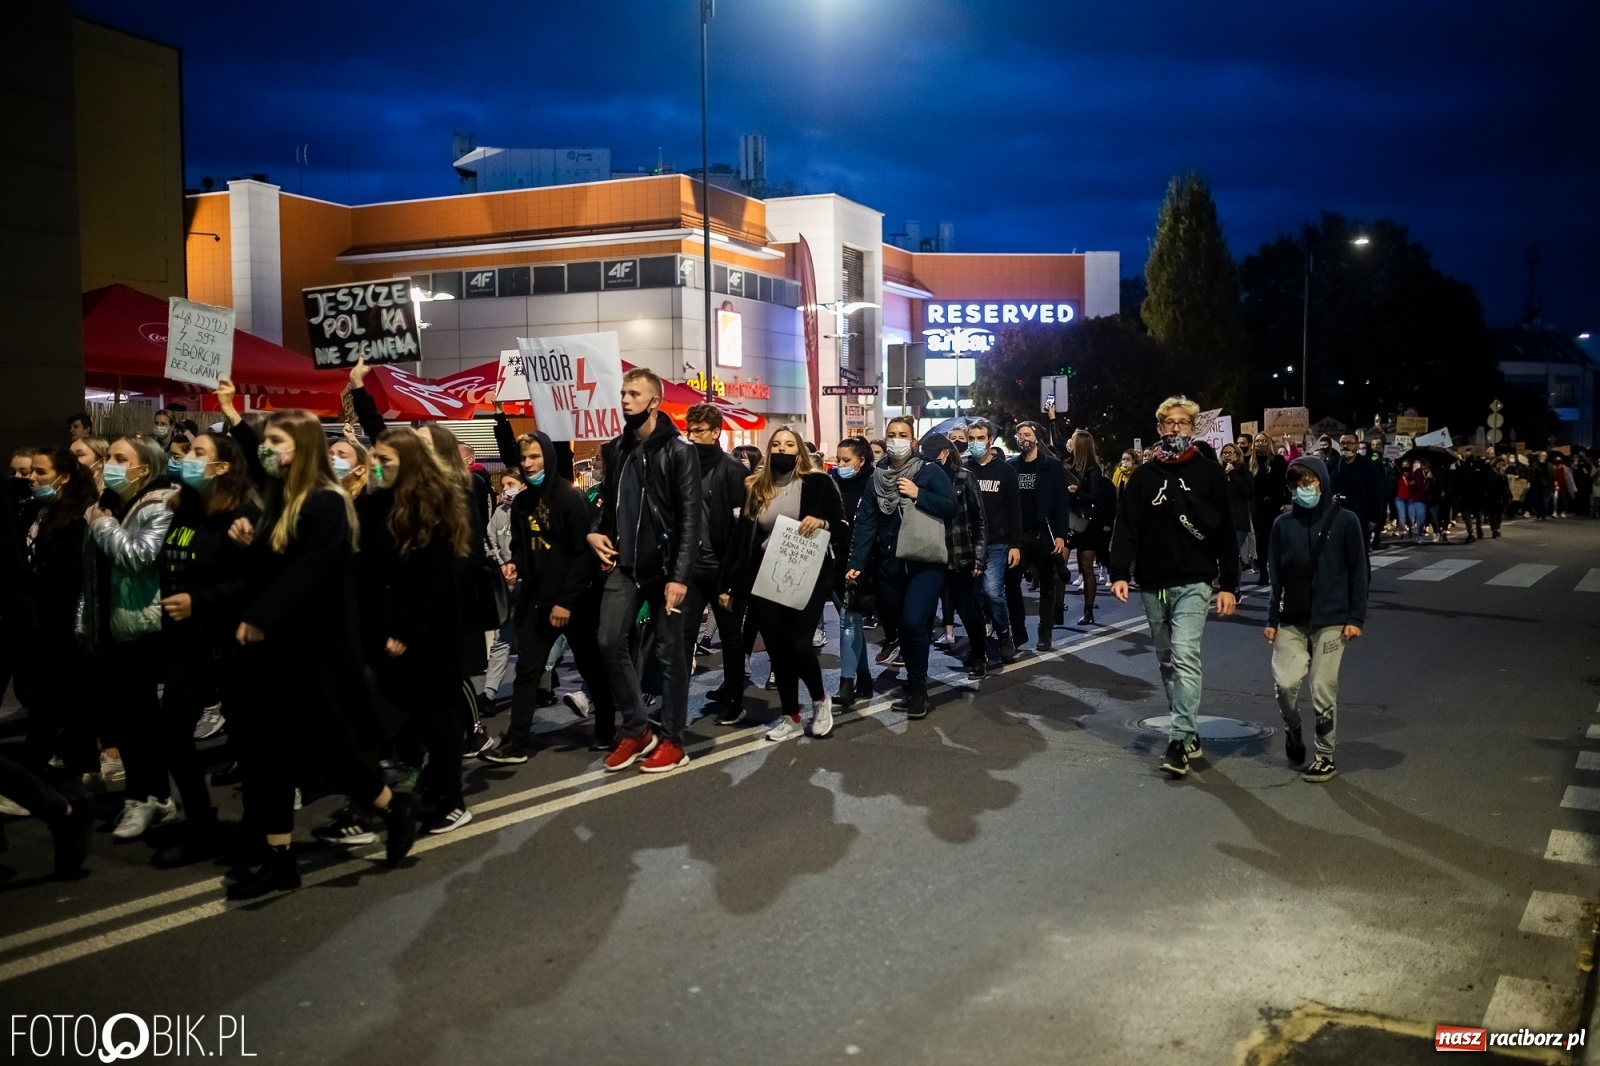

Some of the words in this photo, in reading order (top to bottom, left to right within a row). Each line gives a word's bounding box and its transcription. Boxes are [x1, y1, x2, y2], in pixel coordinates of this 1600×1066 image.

[470, 272, 493, 287] 4F
[608, 261, 634, 278] 4F
[307, 283, 408, 325] JESZCZE
[927, 304, 1074, 324] RESERVED
[170, 357, 189, 372] BEZ
[314, 345, 342, 366] NIE
[551, 384, 579, 412] NIE
[1179, 514, 1205, 540] adidas
